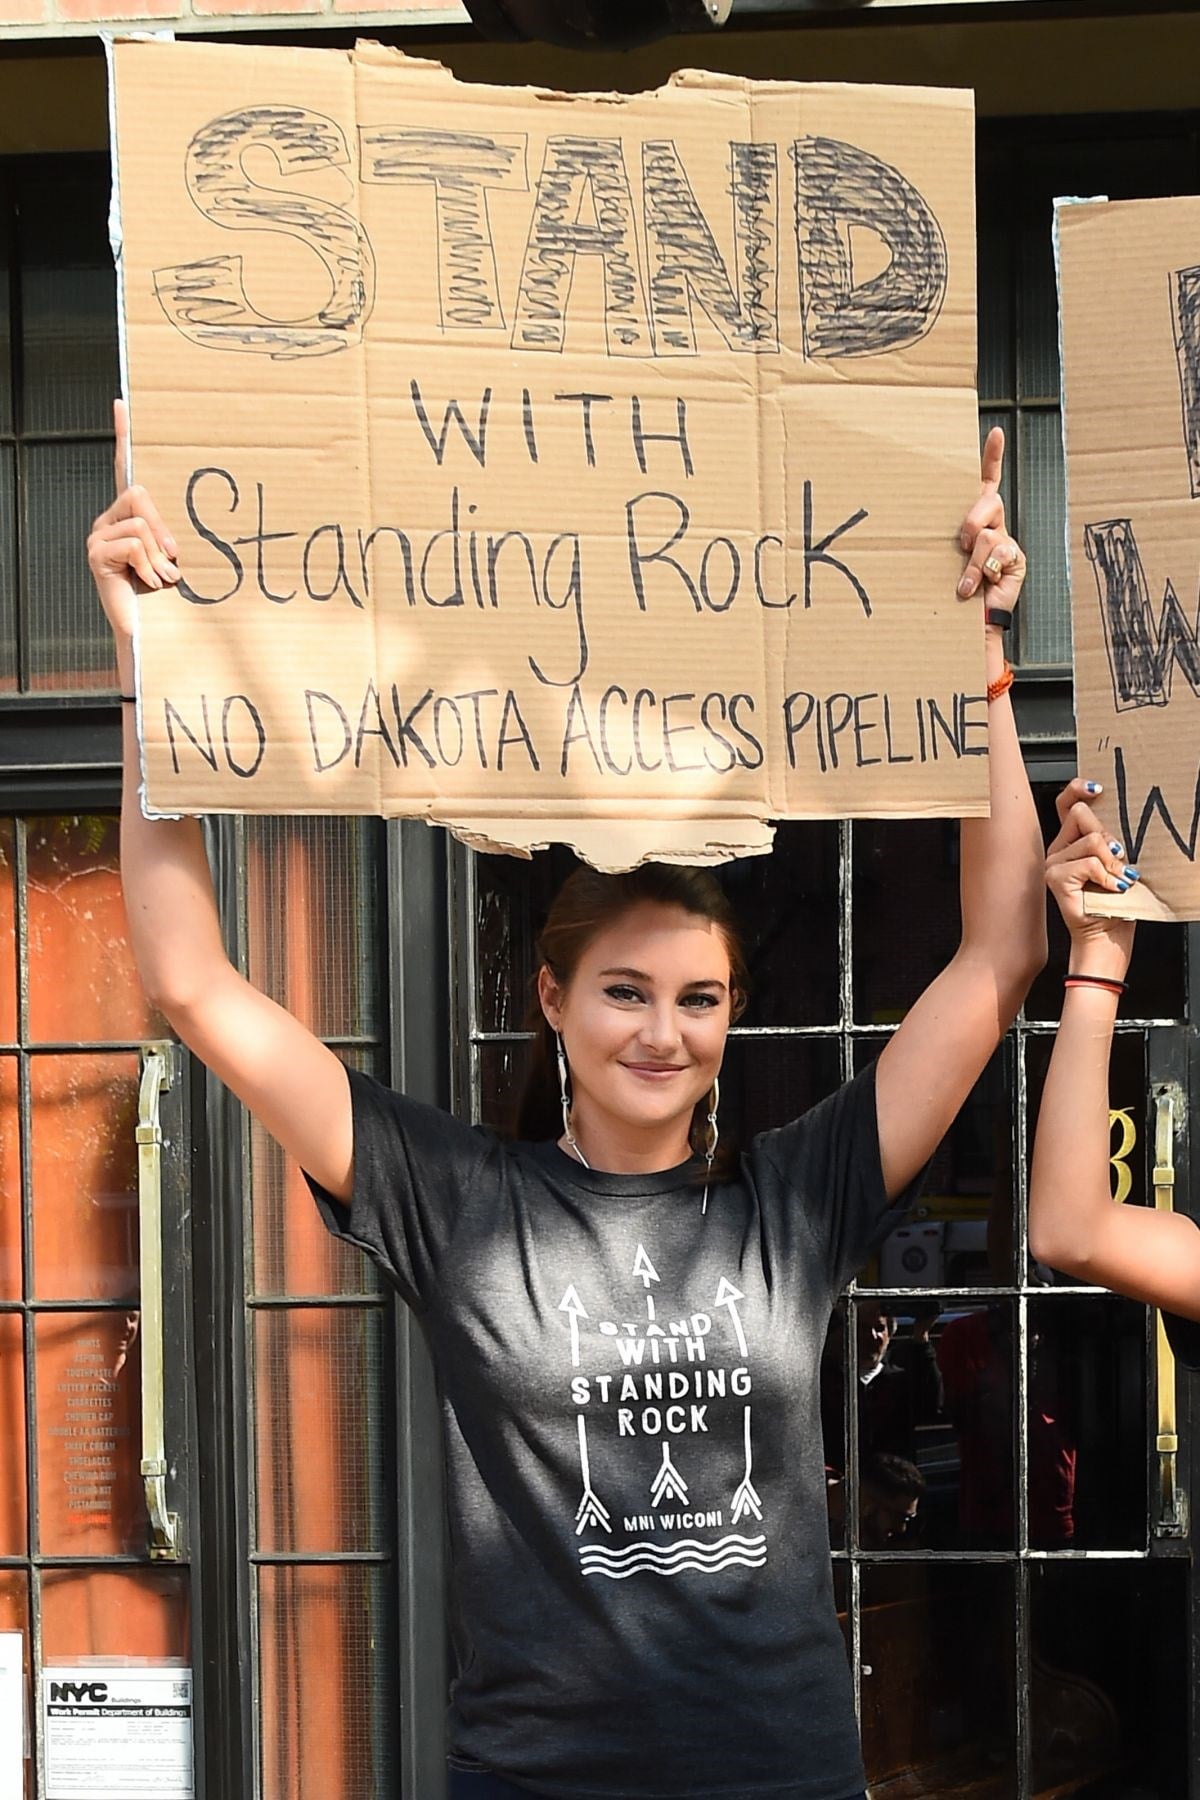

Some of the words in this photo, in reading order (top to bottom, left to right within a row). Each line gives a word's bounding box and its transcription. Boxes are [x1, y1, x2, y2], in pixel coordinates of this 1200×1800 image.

[153, 103, 948, 361] STAND
[411, 378, 694, 478] WITH
[177, 467, 588, 686] Standing
[163, 692, 266, 778] NO
[305, 678, 539, 773] DAKOTA
[560, 682, 764, 777] ACCESS
[784, 692, 990, 773] PIPELINE
[599, 1313, 712, 1337] STAND
[616, 1336, 707, 1366] WITH
[570, 1367, 752, 1405] STANDING
[618, 1405, 709, 1436] ROCK
[624, 1515, 656, 1532] MNI
[659, 1511, 723, 1530] WICONI
[50, 1682, 108, 1702] NYC
[102, 1708, 143, 1717] Department
[145, 1708, 153, 1716] of
